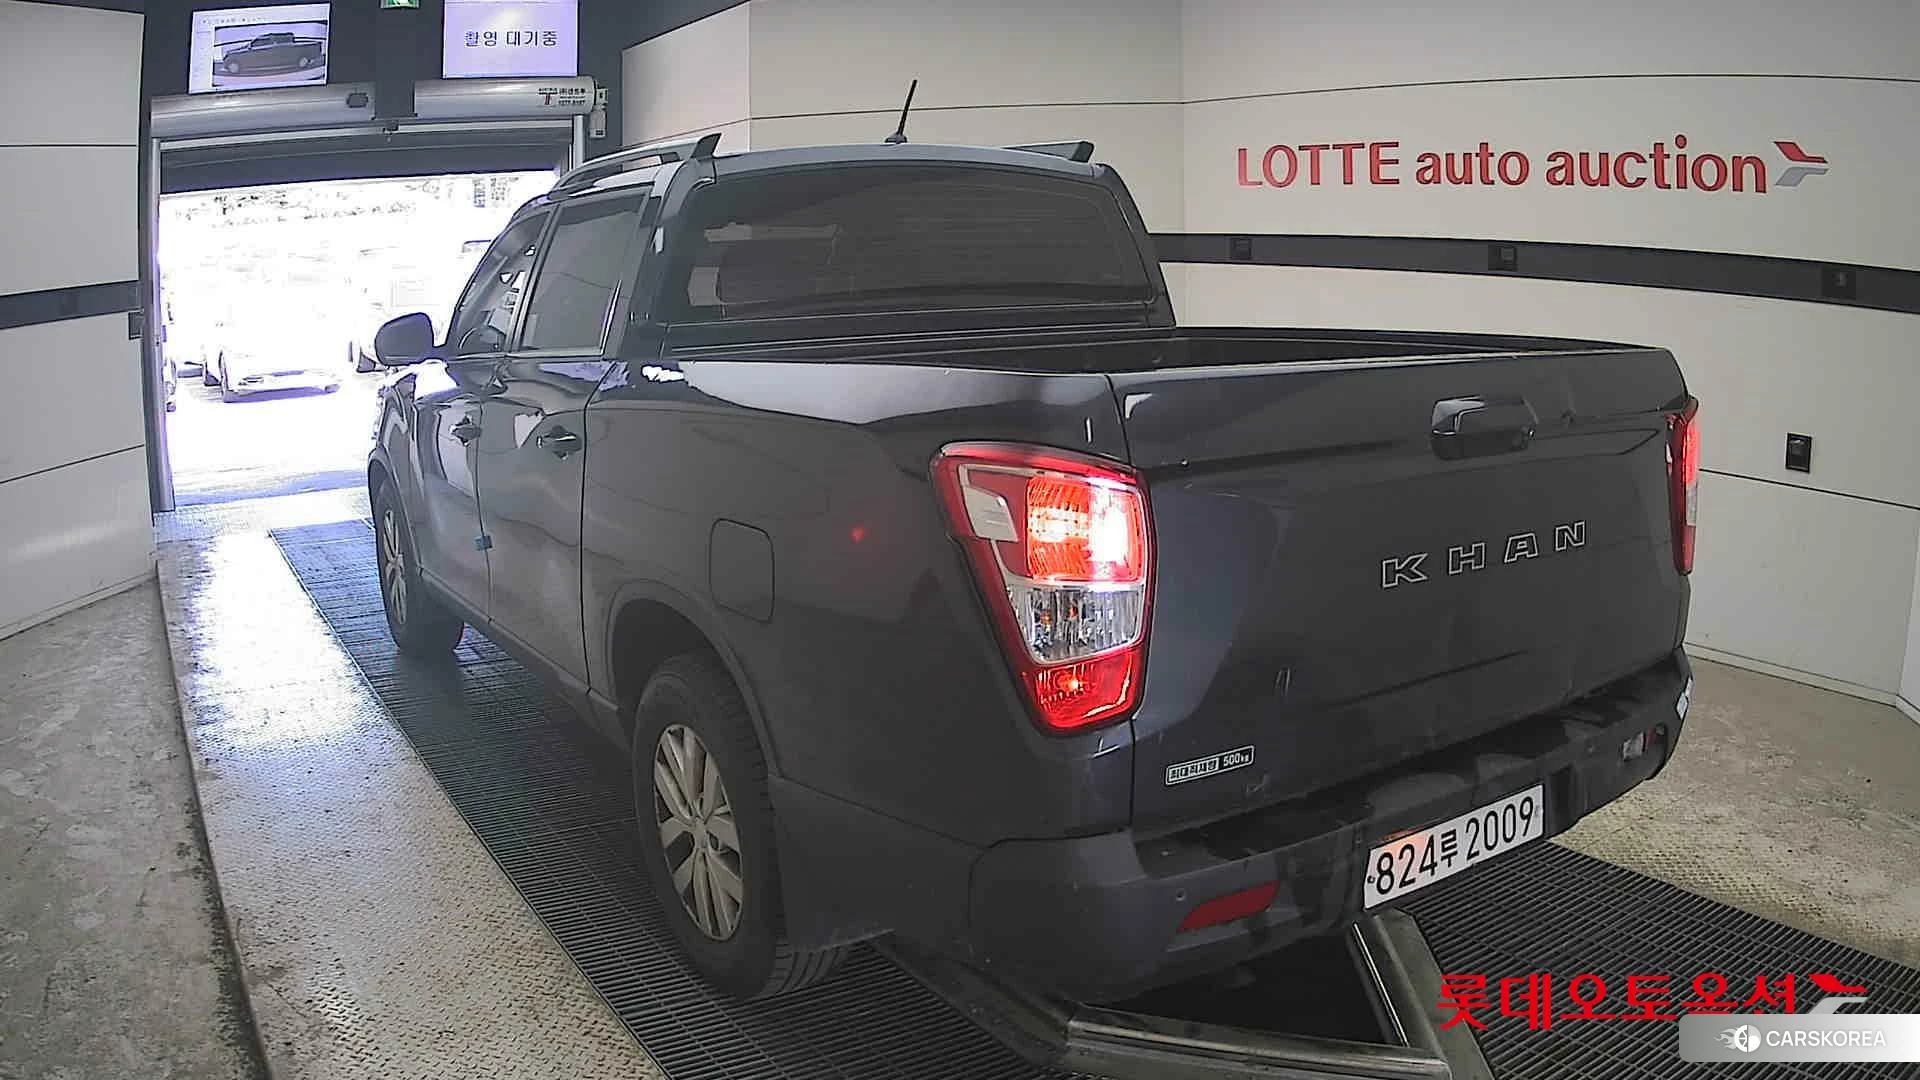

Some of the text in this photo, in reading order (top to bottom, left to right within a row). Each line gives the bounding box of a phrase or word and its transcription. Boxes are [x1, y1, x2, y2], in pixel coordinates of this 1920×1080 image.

[506, 30, 558, 47] 대기중
[1237, 134, 1768, 194] LOTTE auto auction
[1381, 520, 1586, 589] KHAN
